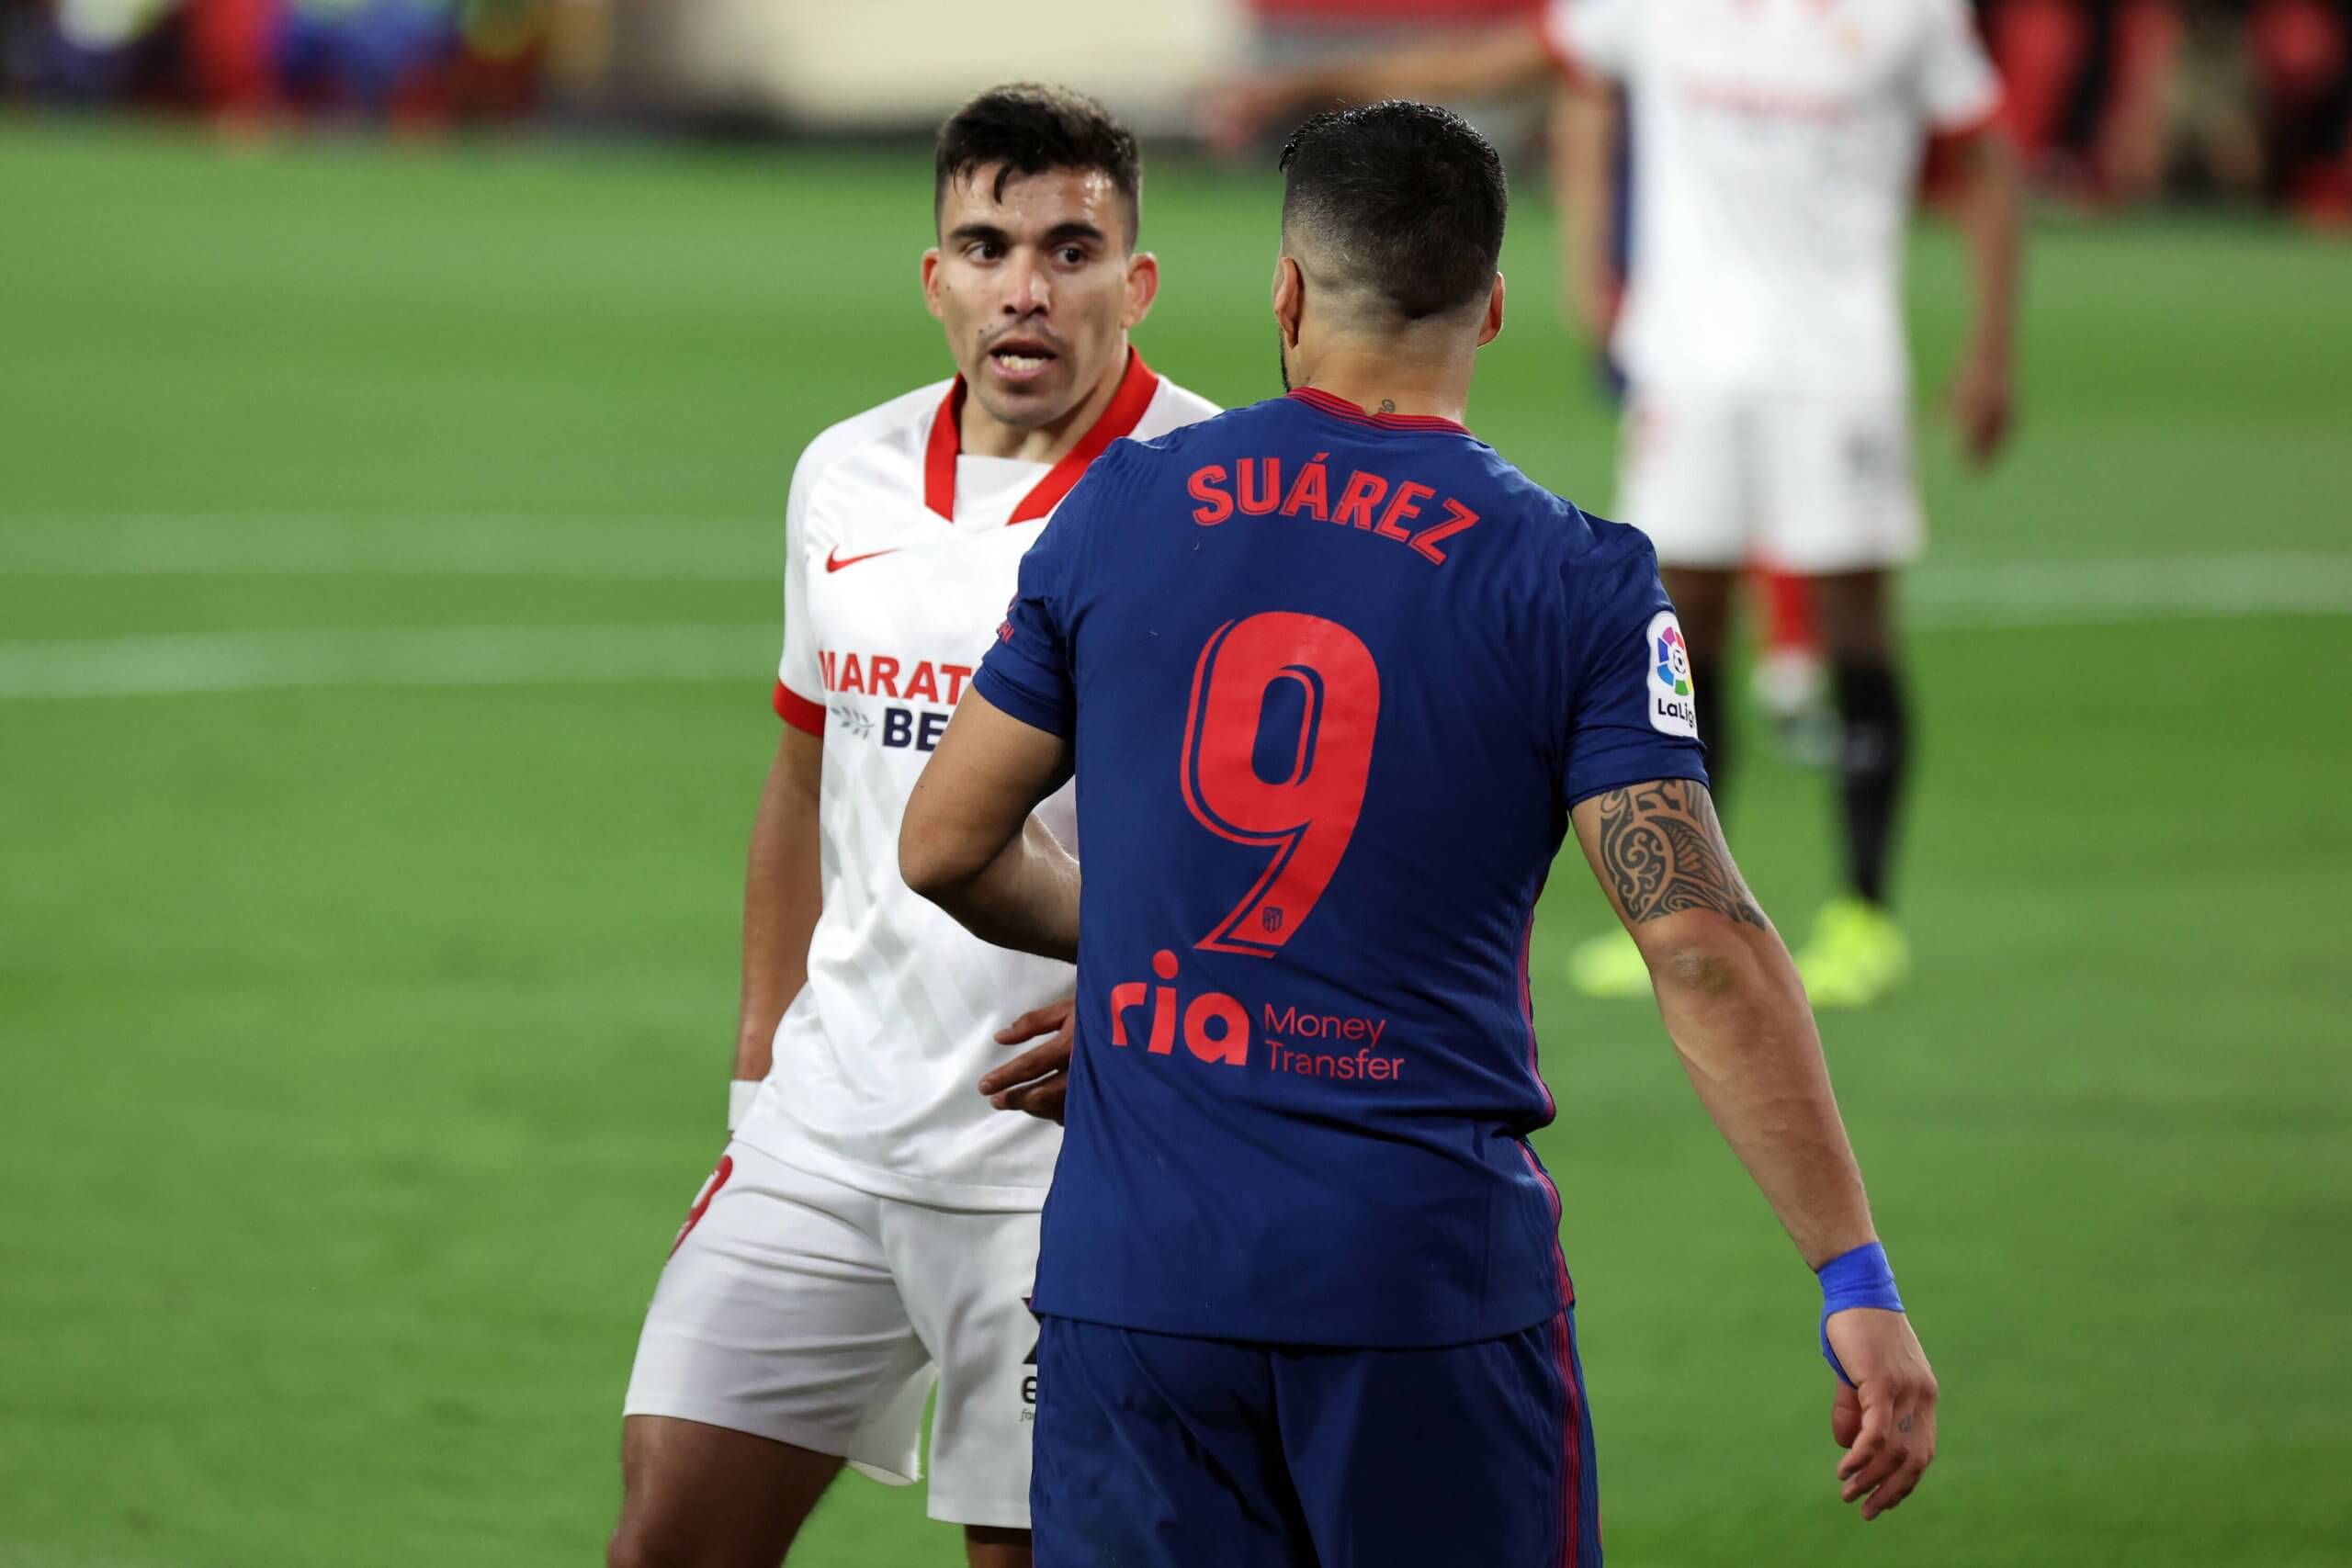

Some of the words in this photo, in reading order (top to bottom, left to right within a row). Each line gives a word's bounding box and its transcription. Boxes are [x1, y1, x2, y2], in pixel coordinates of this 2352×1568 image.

[1188, 453, 1480, 566] SUÁREZ
[1181, 611, 1380, 959] 9
[1110, 949, 1250, 1066] ria
[1264, 1003, 1386, 1045] Money
[1264, 1040, 1406, 1080] Transfer
